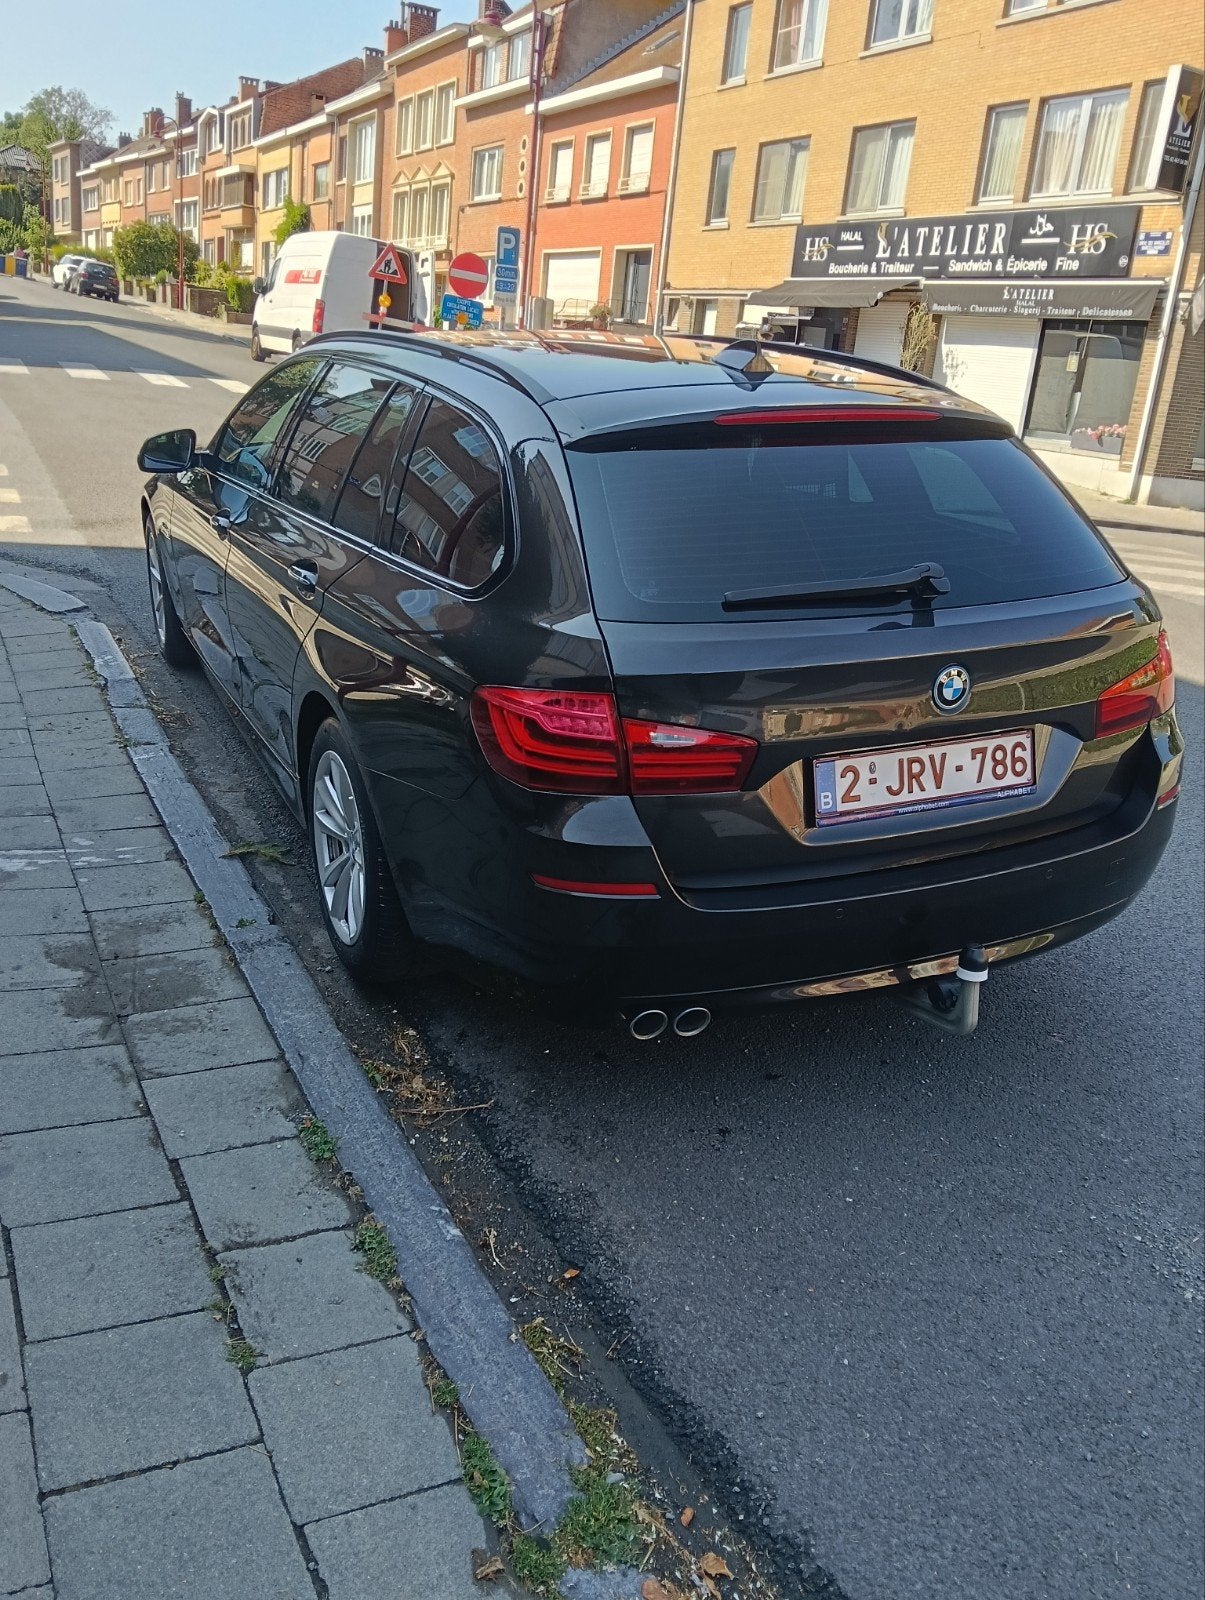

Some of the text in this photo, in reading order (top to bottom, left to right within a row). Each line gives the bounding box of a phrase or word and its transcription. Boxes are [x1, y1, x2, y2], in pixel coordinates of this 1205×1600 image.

[1168, 137, 1191, 148] ATELIER
[840, 231, 863, 241] HALAL
[876, 222, 1006, 258] L'ATELIER
[1066, 223, 1108, 255] HS
[499, 232, 516, 260] P
[803, 236, 830, 262] HS
[828, 260, 914, 275] Boucherie & Traiteur
[949, 255, 1080, 273] Sandwich & Épicerie Fine
[1002, 286, 1055, 300] L'ATELIER
[970, 304, 1007, 314] Charcuterie
[1014, 304, 1041, 316] Slagerij
[1047, 306, 1076, 316] Traiteur
[1082, 306, 1133, 317] Delicatessen
[941, 669, 967, 683] BMW
[820, 791, 833, 809] B
[997, 787, 1031, 798] ALPHABET
